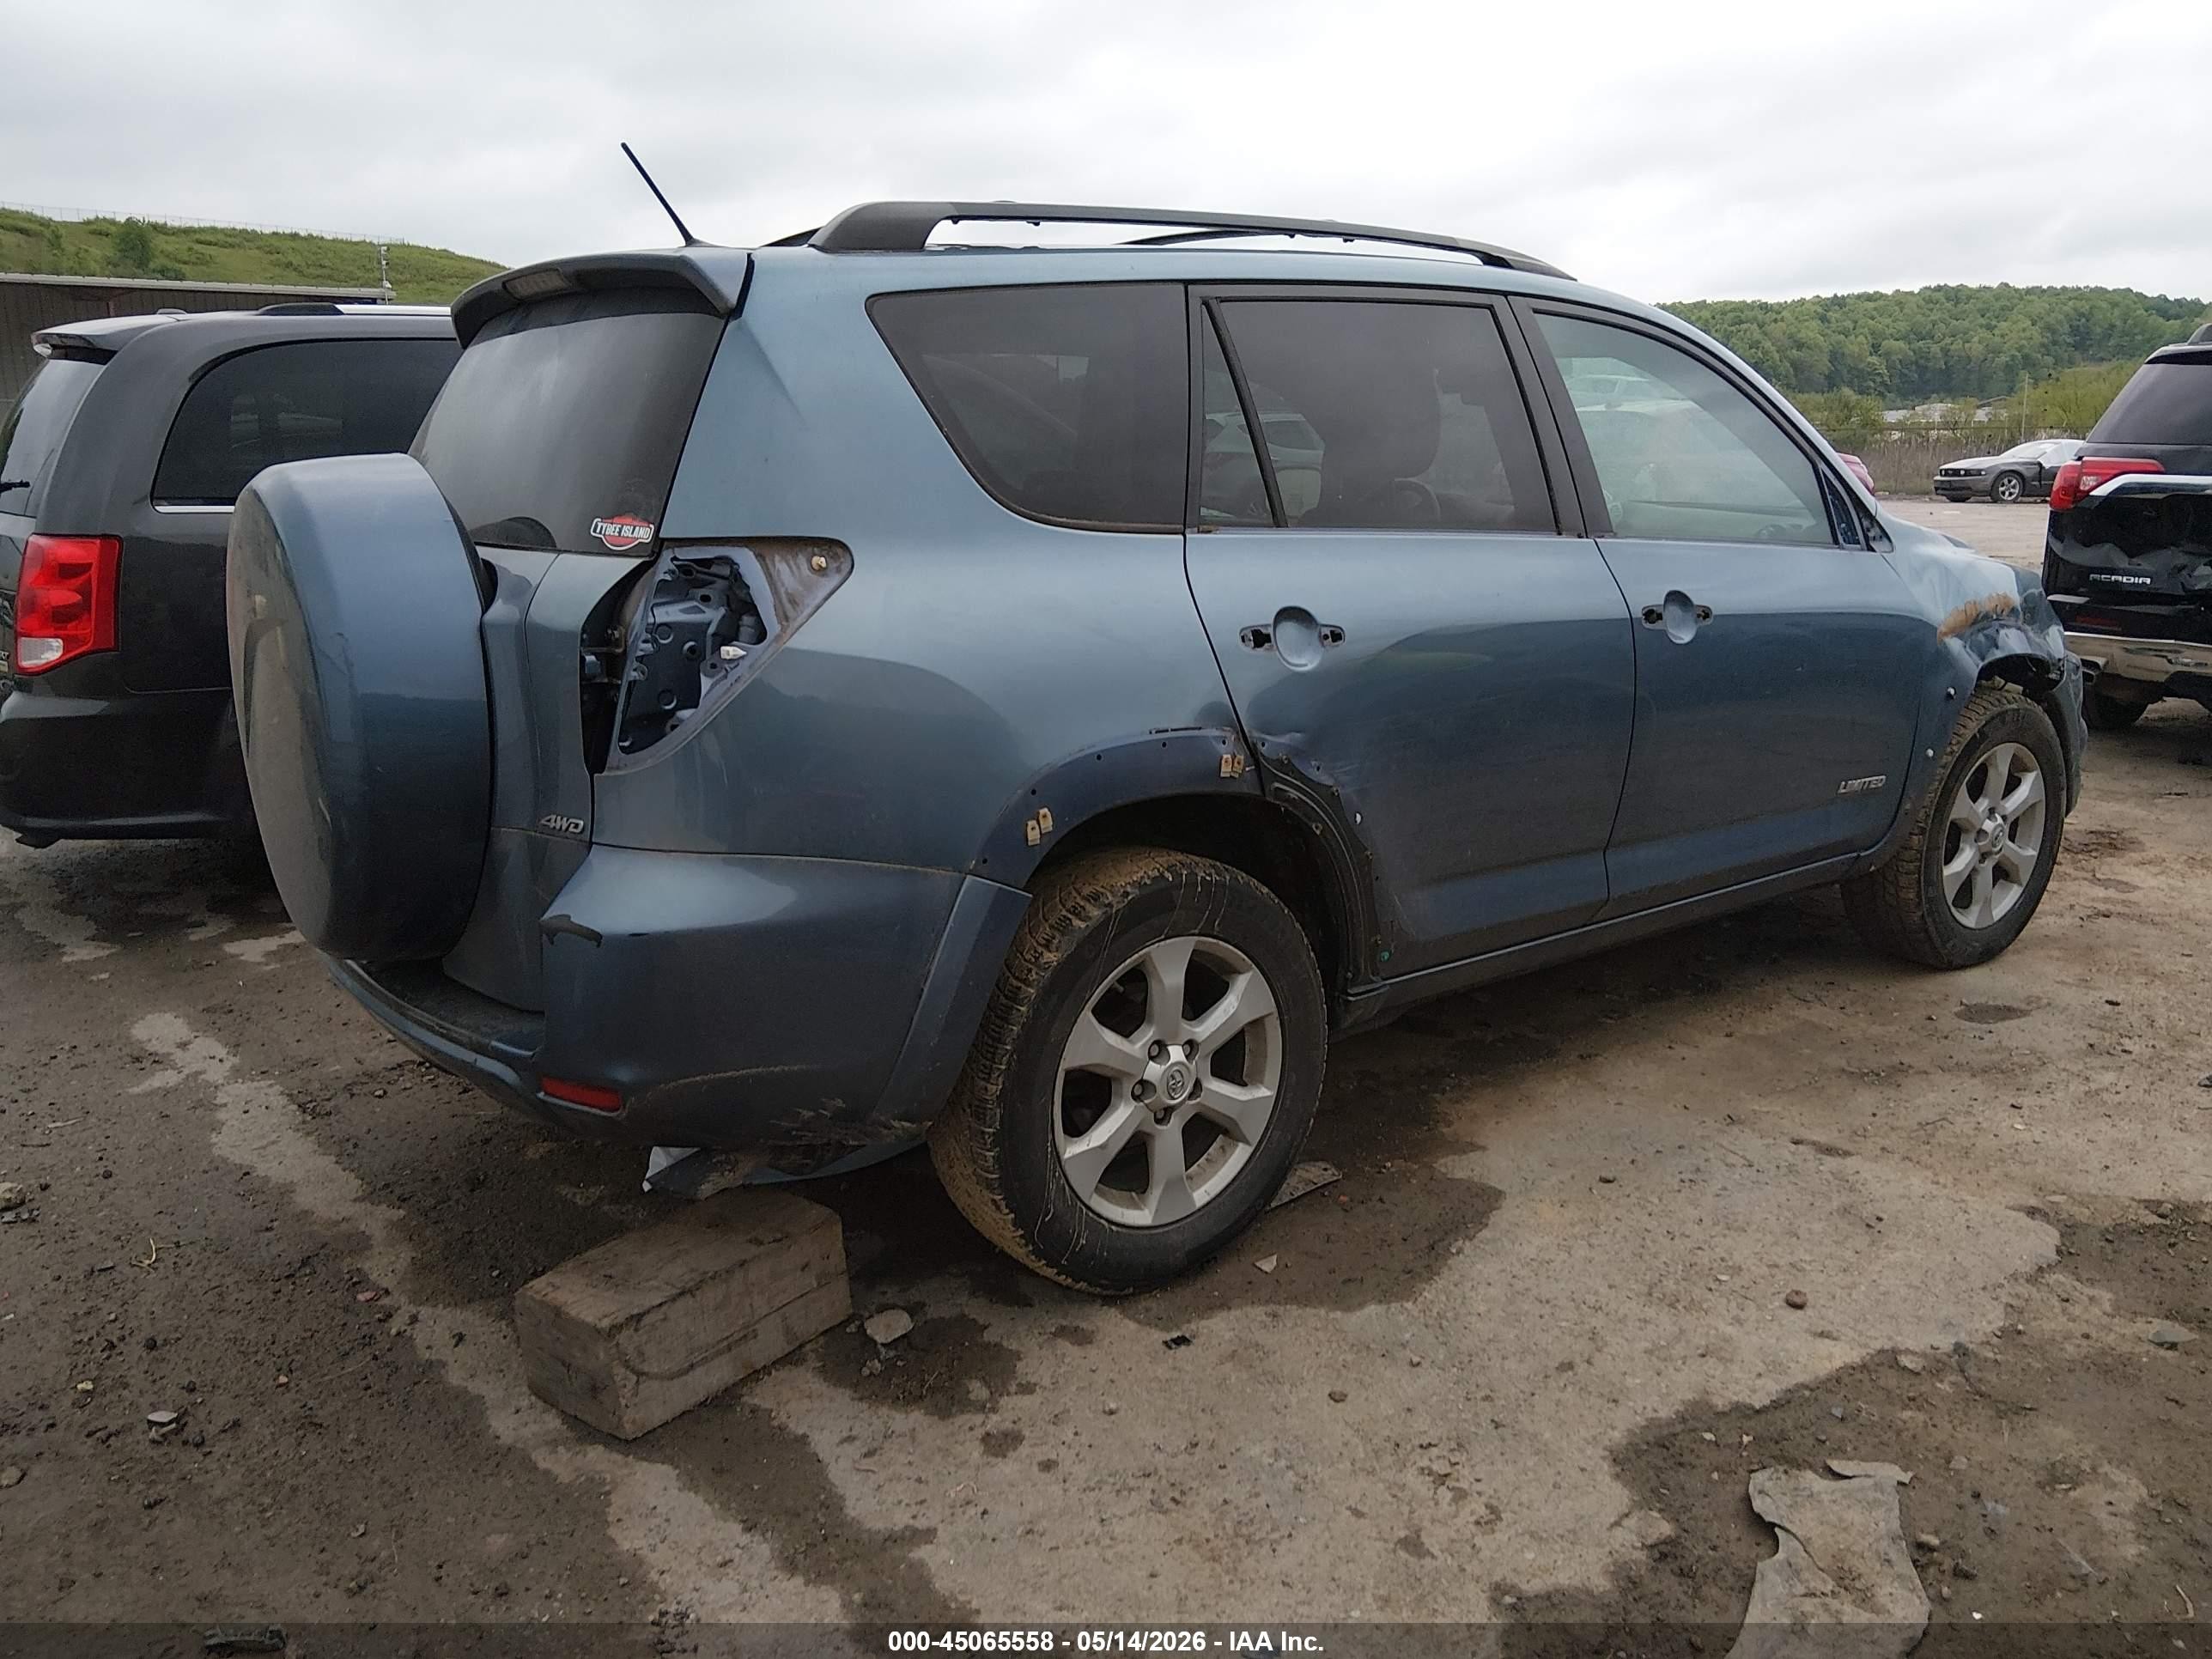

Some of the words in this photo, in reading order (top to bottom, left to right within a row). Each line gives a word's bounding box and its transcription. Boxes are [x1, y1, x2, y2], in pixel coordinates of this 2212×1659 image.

[596, 521, 622, 536] TYBEE
[621, 525, 651, 539] ISLAND
[2089, 574, 2151, 585] ACADIA
[1838, 775, 1887, 793] LIMITED
[540, 814, 584, 833] 4WD
